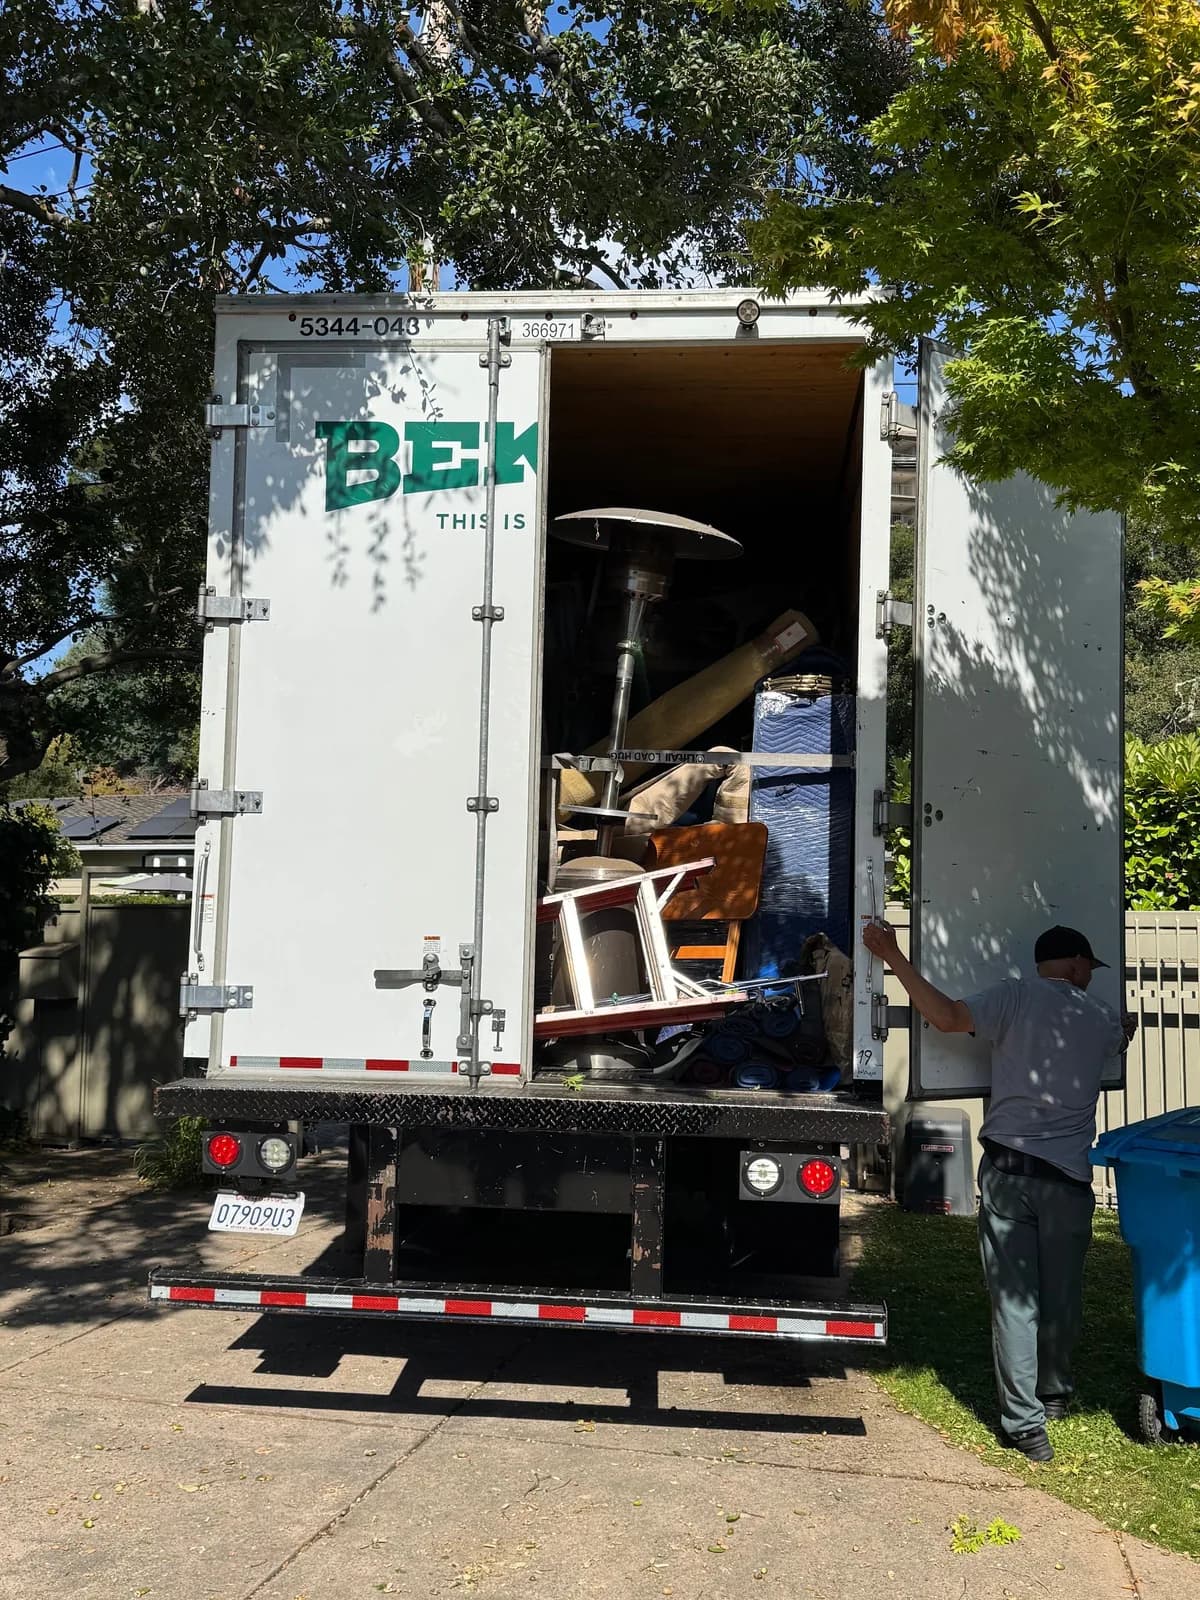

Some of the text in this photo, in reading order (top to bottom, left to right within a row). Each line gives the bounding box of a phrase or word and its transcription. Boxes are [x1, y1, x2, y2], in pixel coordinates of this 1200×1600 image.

[300, 317, 420, 337] 5344-043
[522, 322, 575, 338] 366971
[436, 513, 526, 530] THIS IS
[634, 752, 661, 762] LOAD
[217, 1203, 295, 1228] 07909U3
